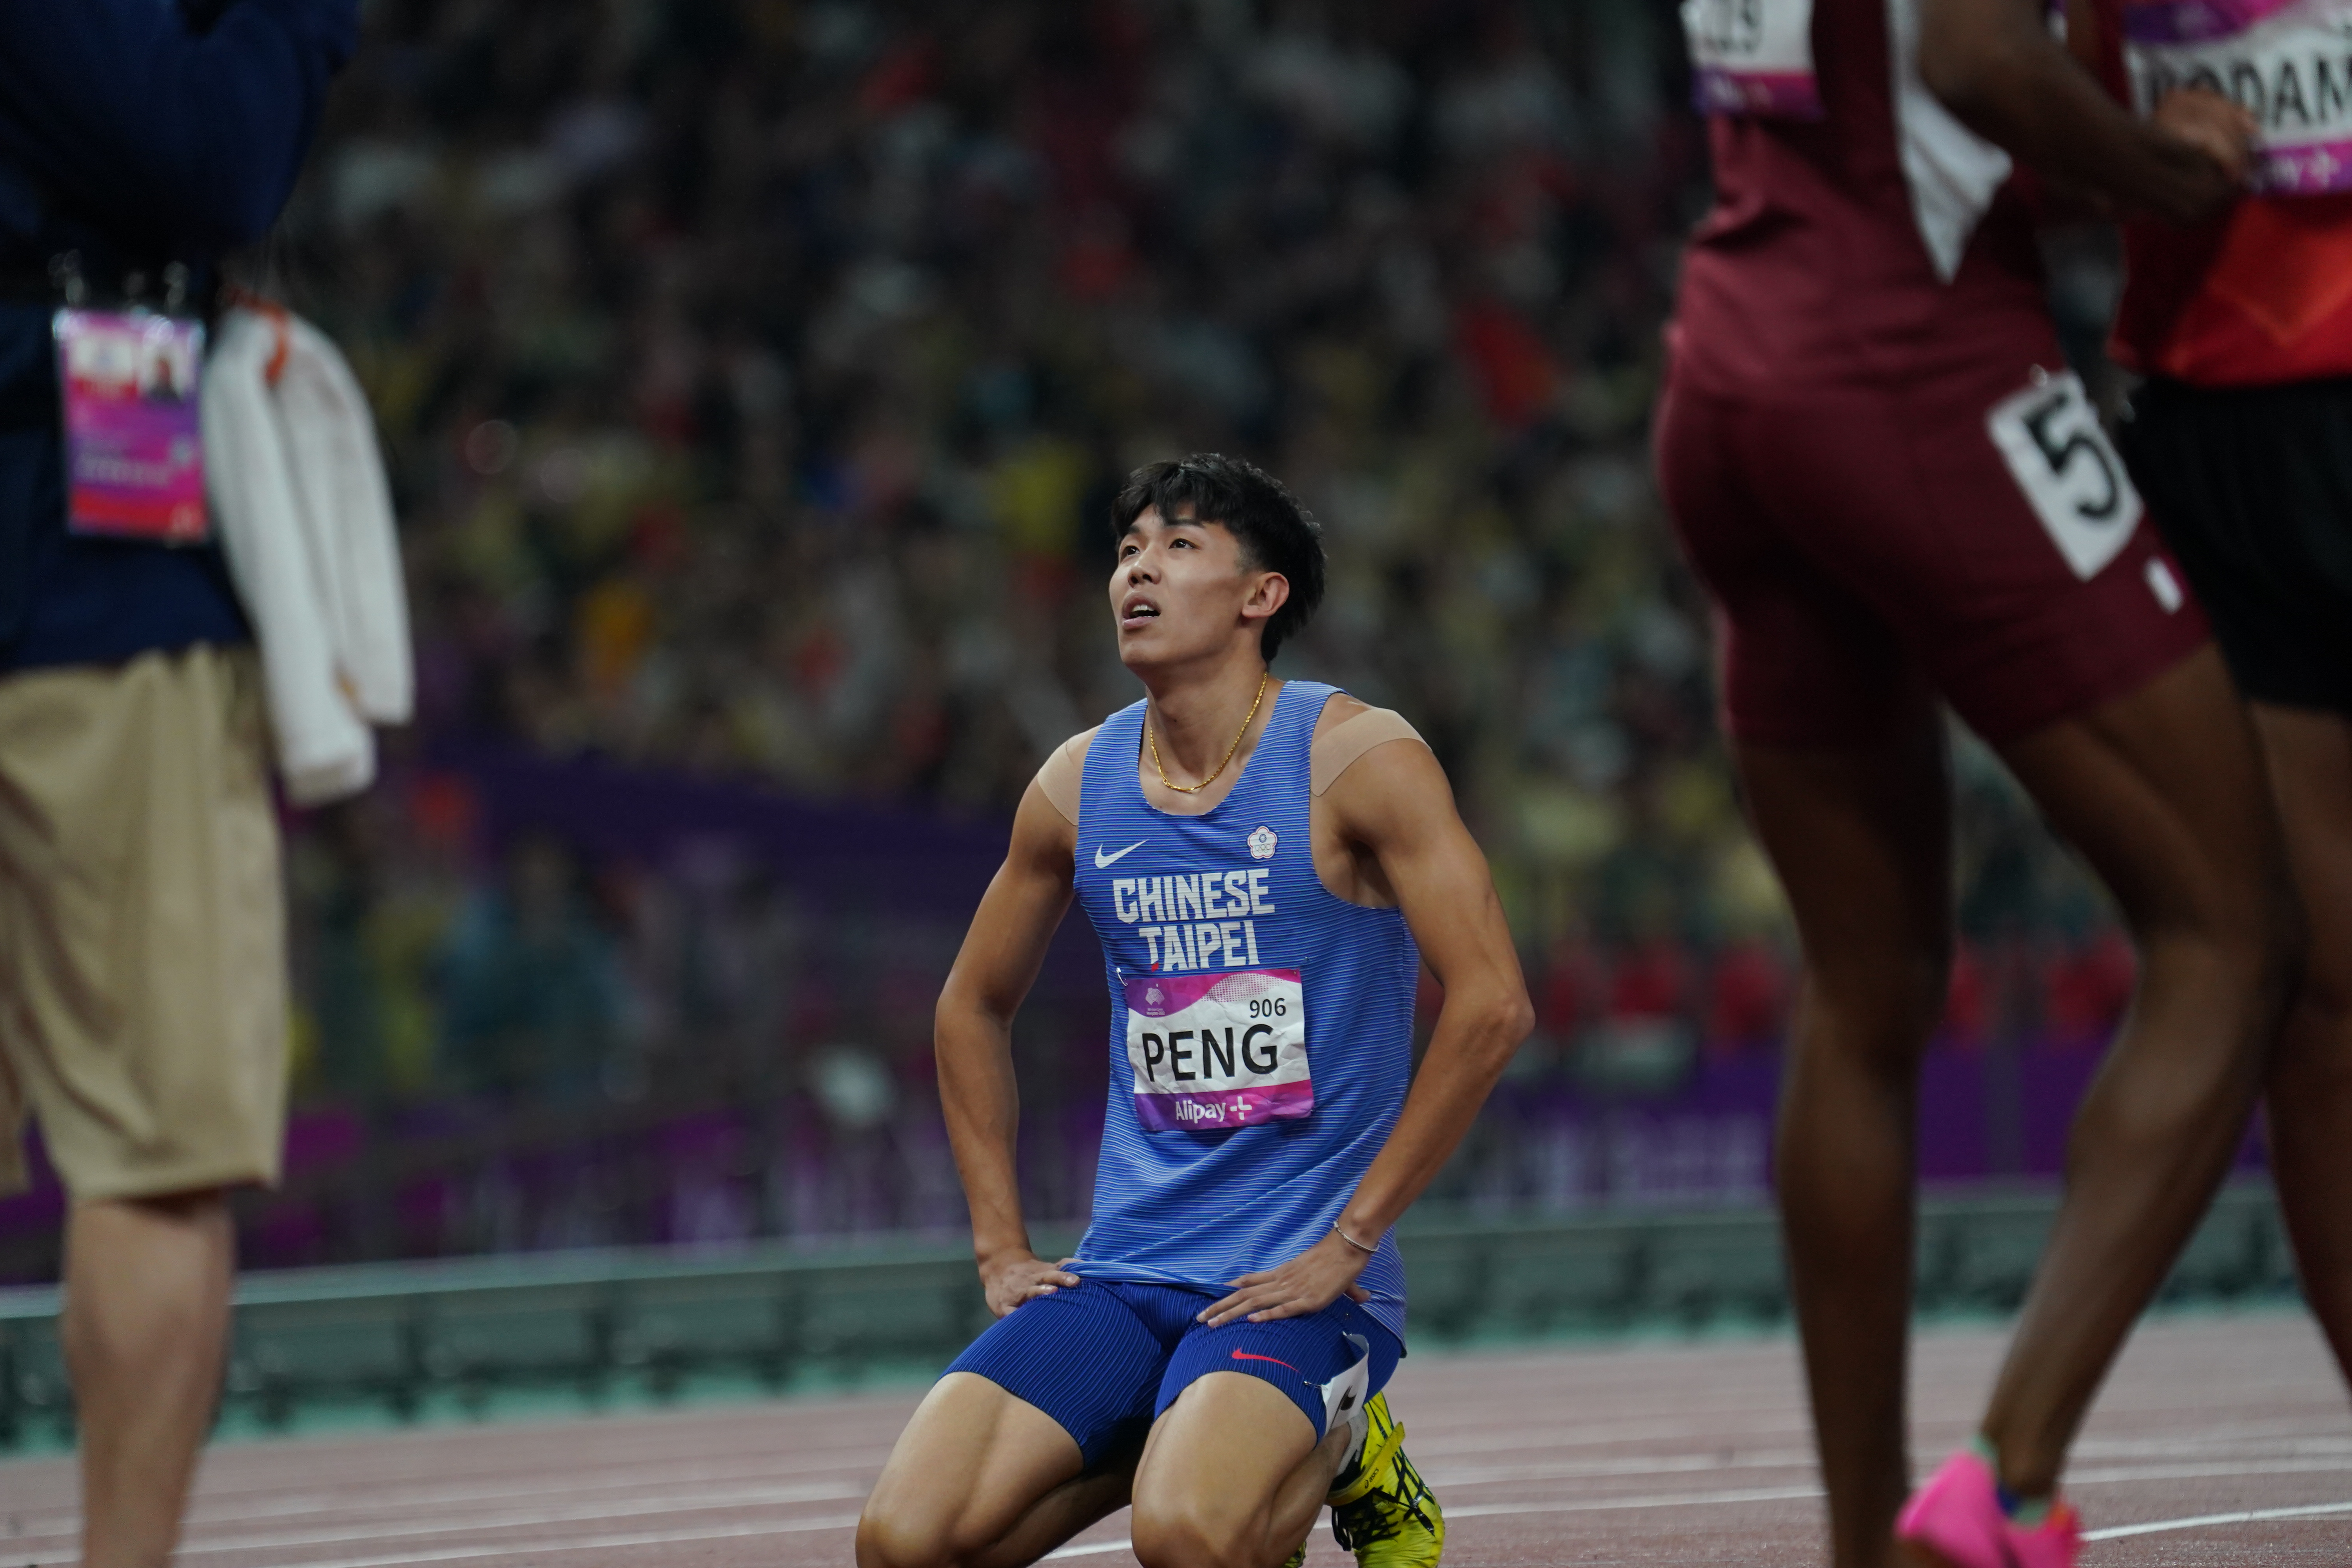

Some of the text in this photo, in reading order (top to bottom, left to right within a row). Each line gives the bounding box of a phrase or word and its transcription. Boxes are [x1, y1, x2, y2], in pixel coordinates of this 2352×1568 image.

[2022, 392, 2120, 523] 5
[1113, 868, 1275, 924] CHINESE
[1139, 920, 1260, 972] TAIPEI
[1250, 998, 1286, 1018] 906
[1142, 1024, 1278, 1082] PENG
